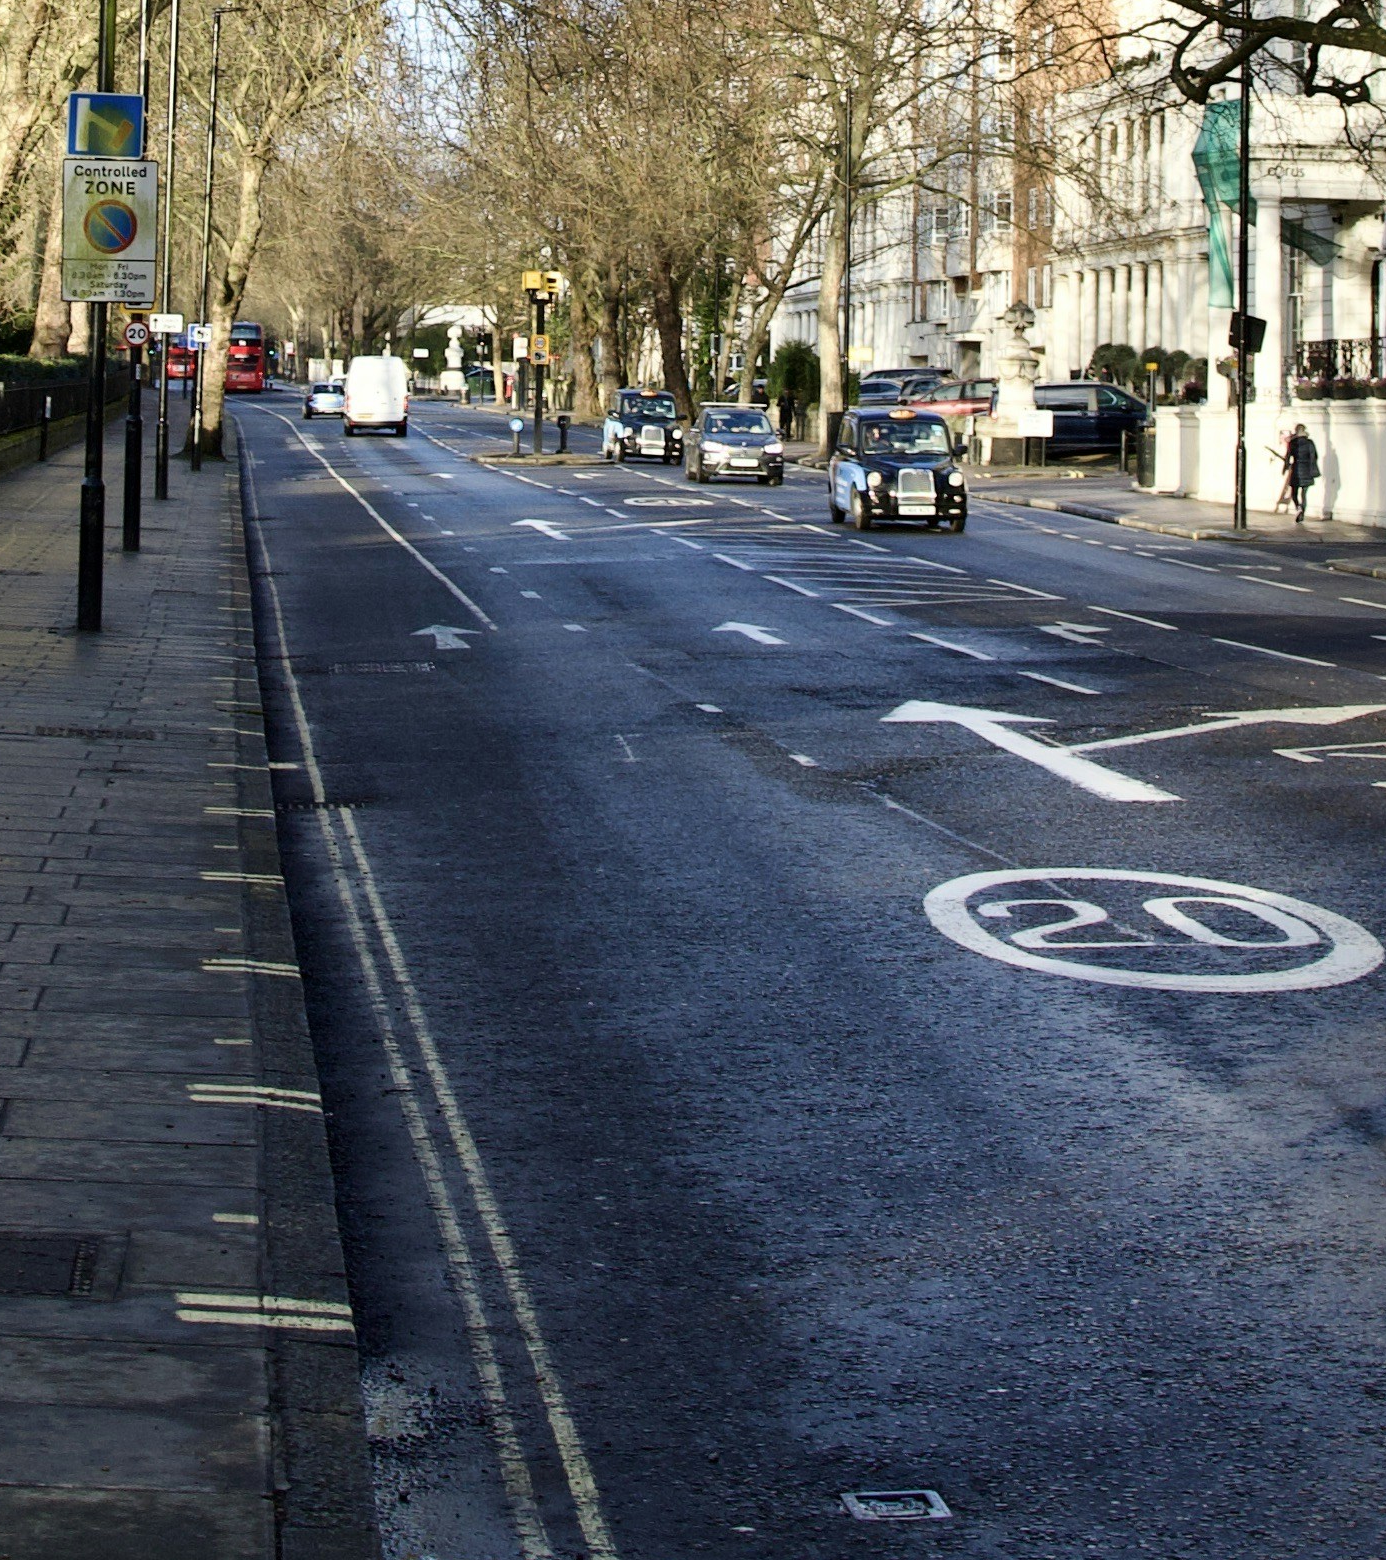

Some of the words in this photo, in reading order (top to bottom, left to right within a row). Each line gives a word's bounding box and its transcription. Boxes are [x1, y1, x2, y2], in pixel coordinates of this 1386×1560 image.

[74, 165, 147, 178] Controlled
[85, 181, 136, 195] ZONE
[128, 328, 145, 339] 20
[975, 896, 1322, 949] 20
